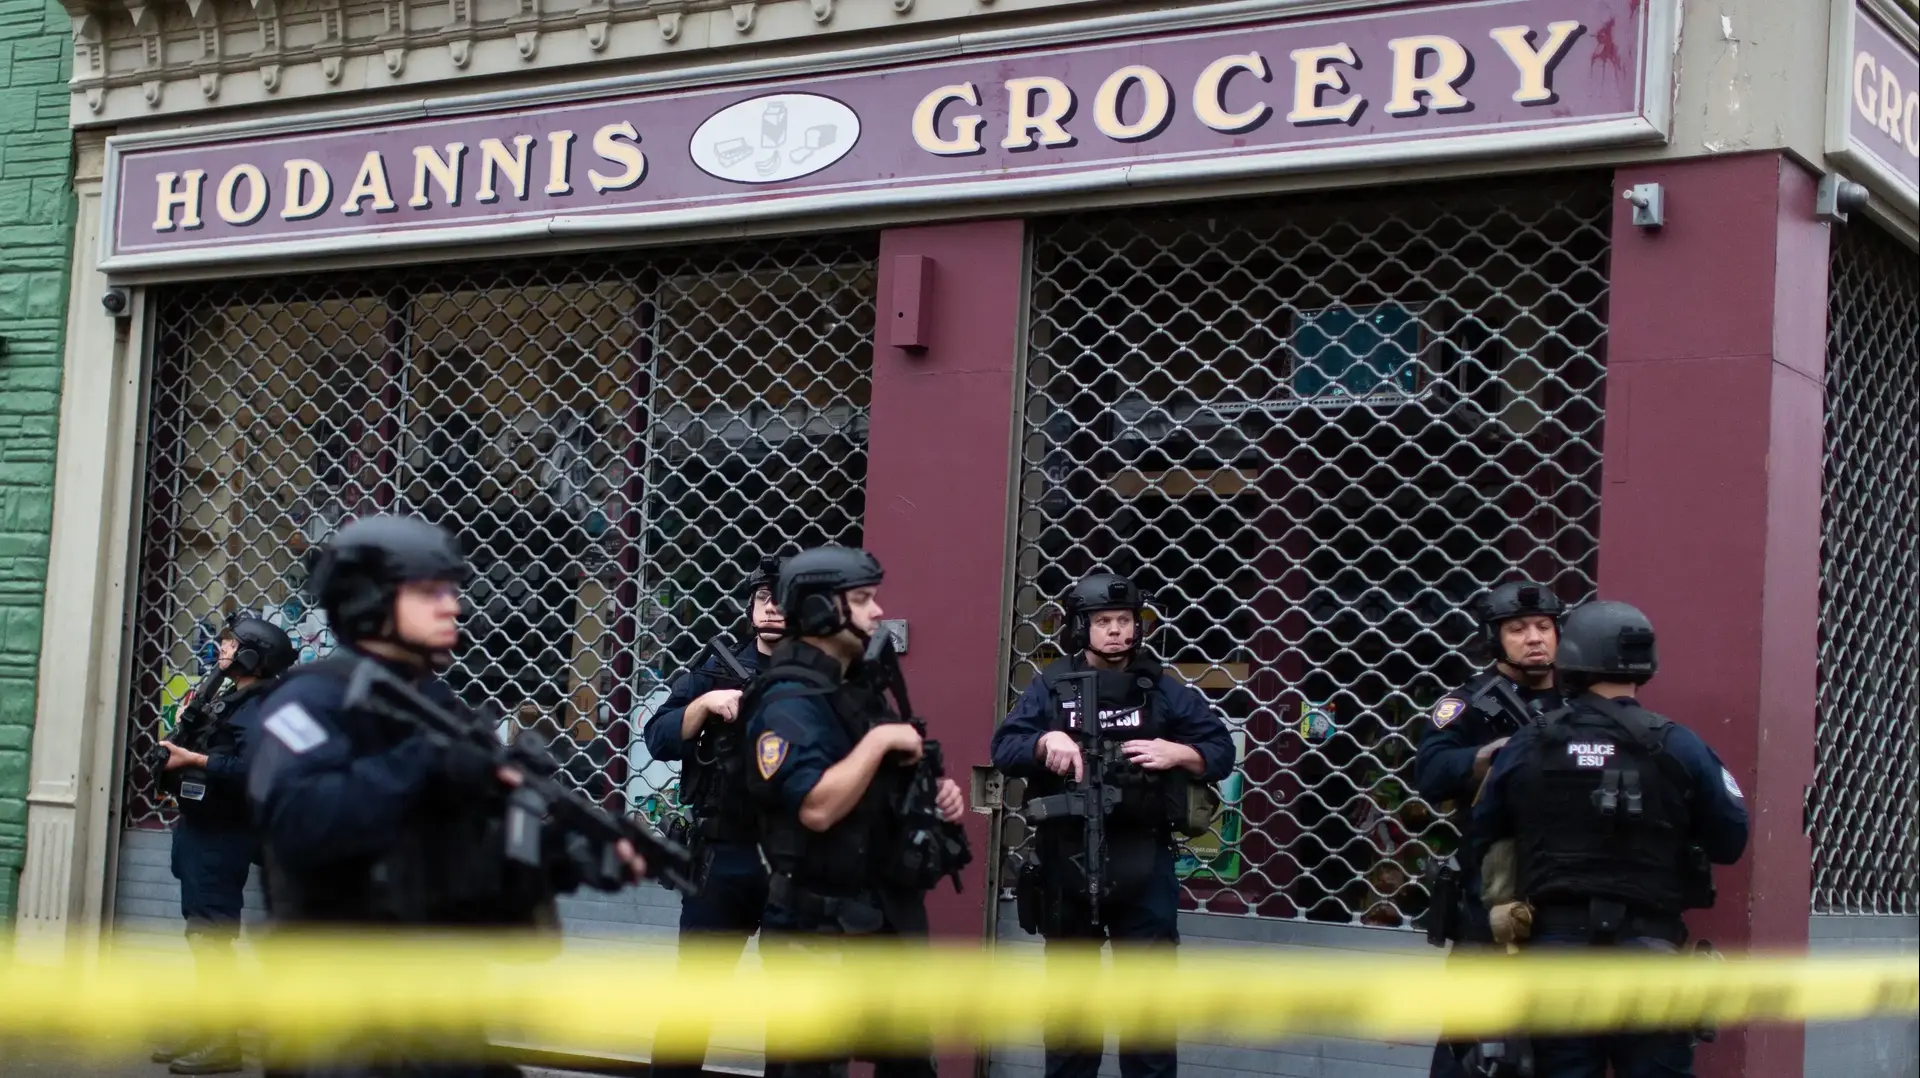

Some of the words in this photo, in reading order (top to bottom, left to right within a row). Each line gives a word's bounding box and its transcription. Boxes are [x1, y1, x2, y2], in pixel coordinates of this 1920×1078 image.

[152, 119, 648, 233] HODANNIS
[911, 18, 1586, 157] GROCERY
[1568, 743, 1615, 755] POLICE
[1578, 755, 1604, 767] ESU
